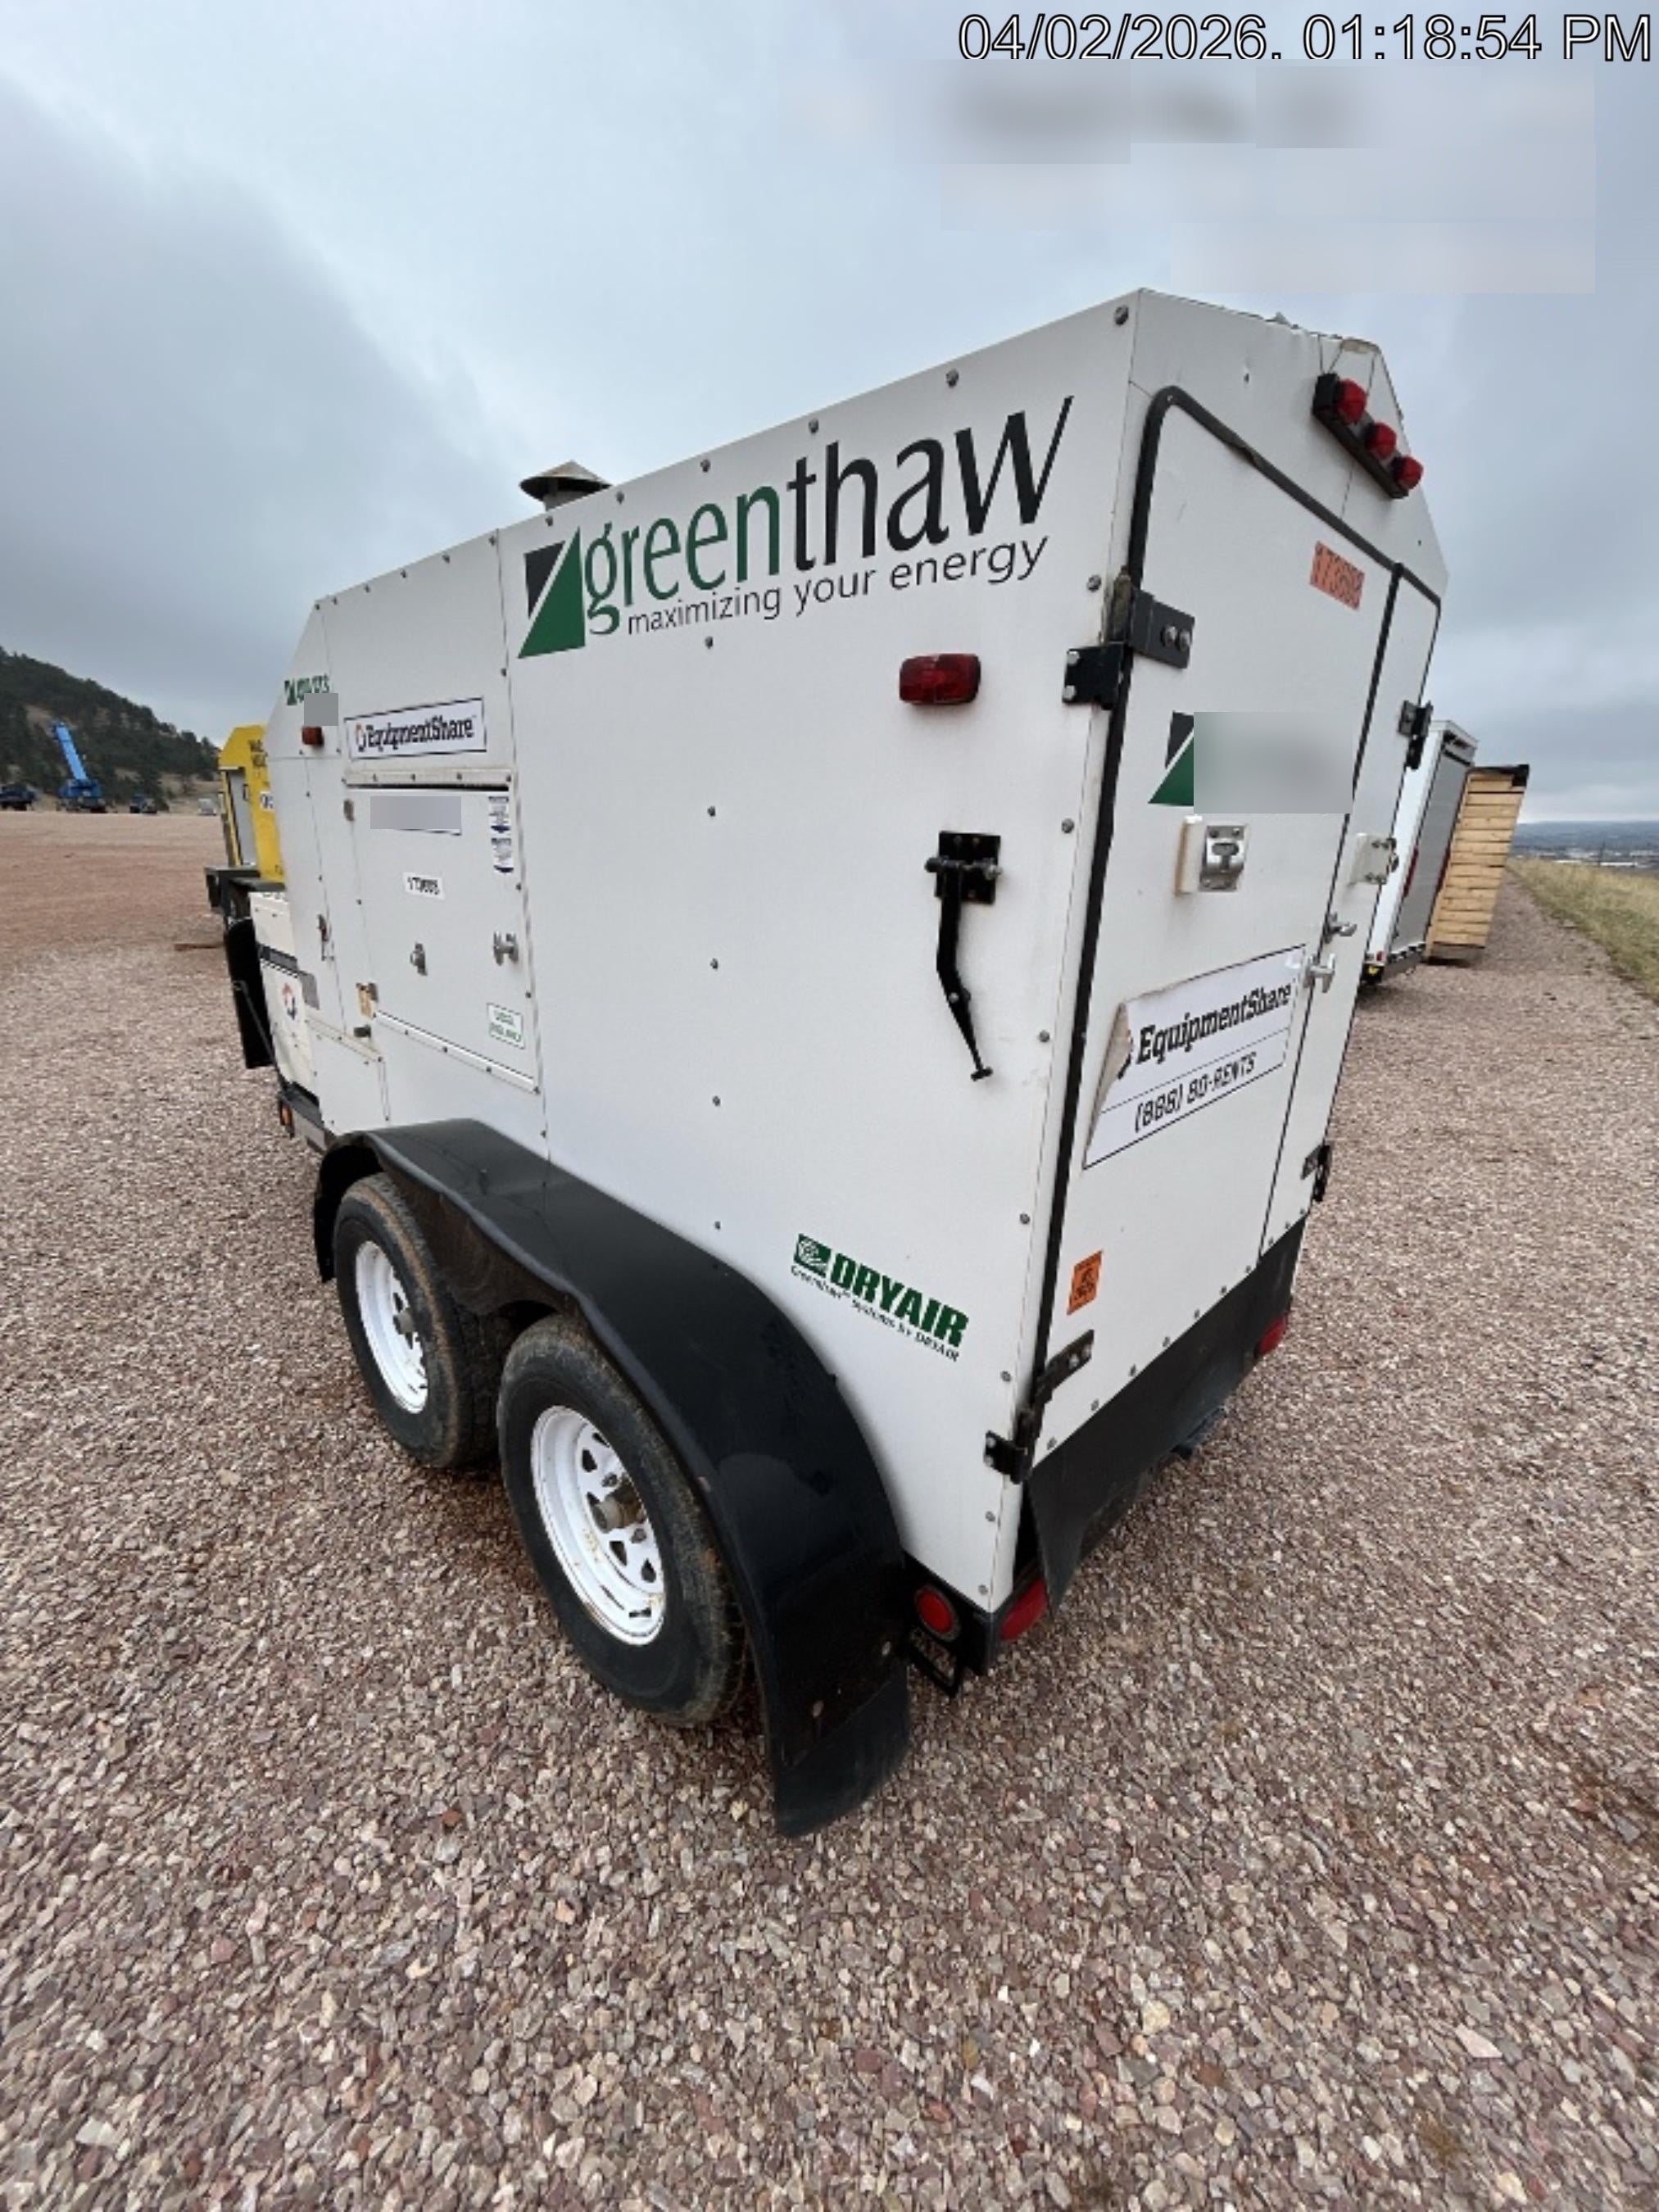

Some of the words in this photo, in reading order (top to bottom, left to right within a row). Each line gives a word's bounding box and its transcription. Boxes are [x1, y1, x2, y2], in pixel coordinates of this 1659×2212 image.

[584, 395, 1074, 635] greenthaw
[628, 586, 781, 635] maximizing
[793, 569, 877, 618] your
[890, 535, 1049, 592] energy
[365, 714, 474, 752] EquipmentShare
[1135, 984, 1292, 1065] EquipmentShare
[1135, 1083, 1184, 1134] (888)
[829, 1253, 969, 1348] DRYAIR
